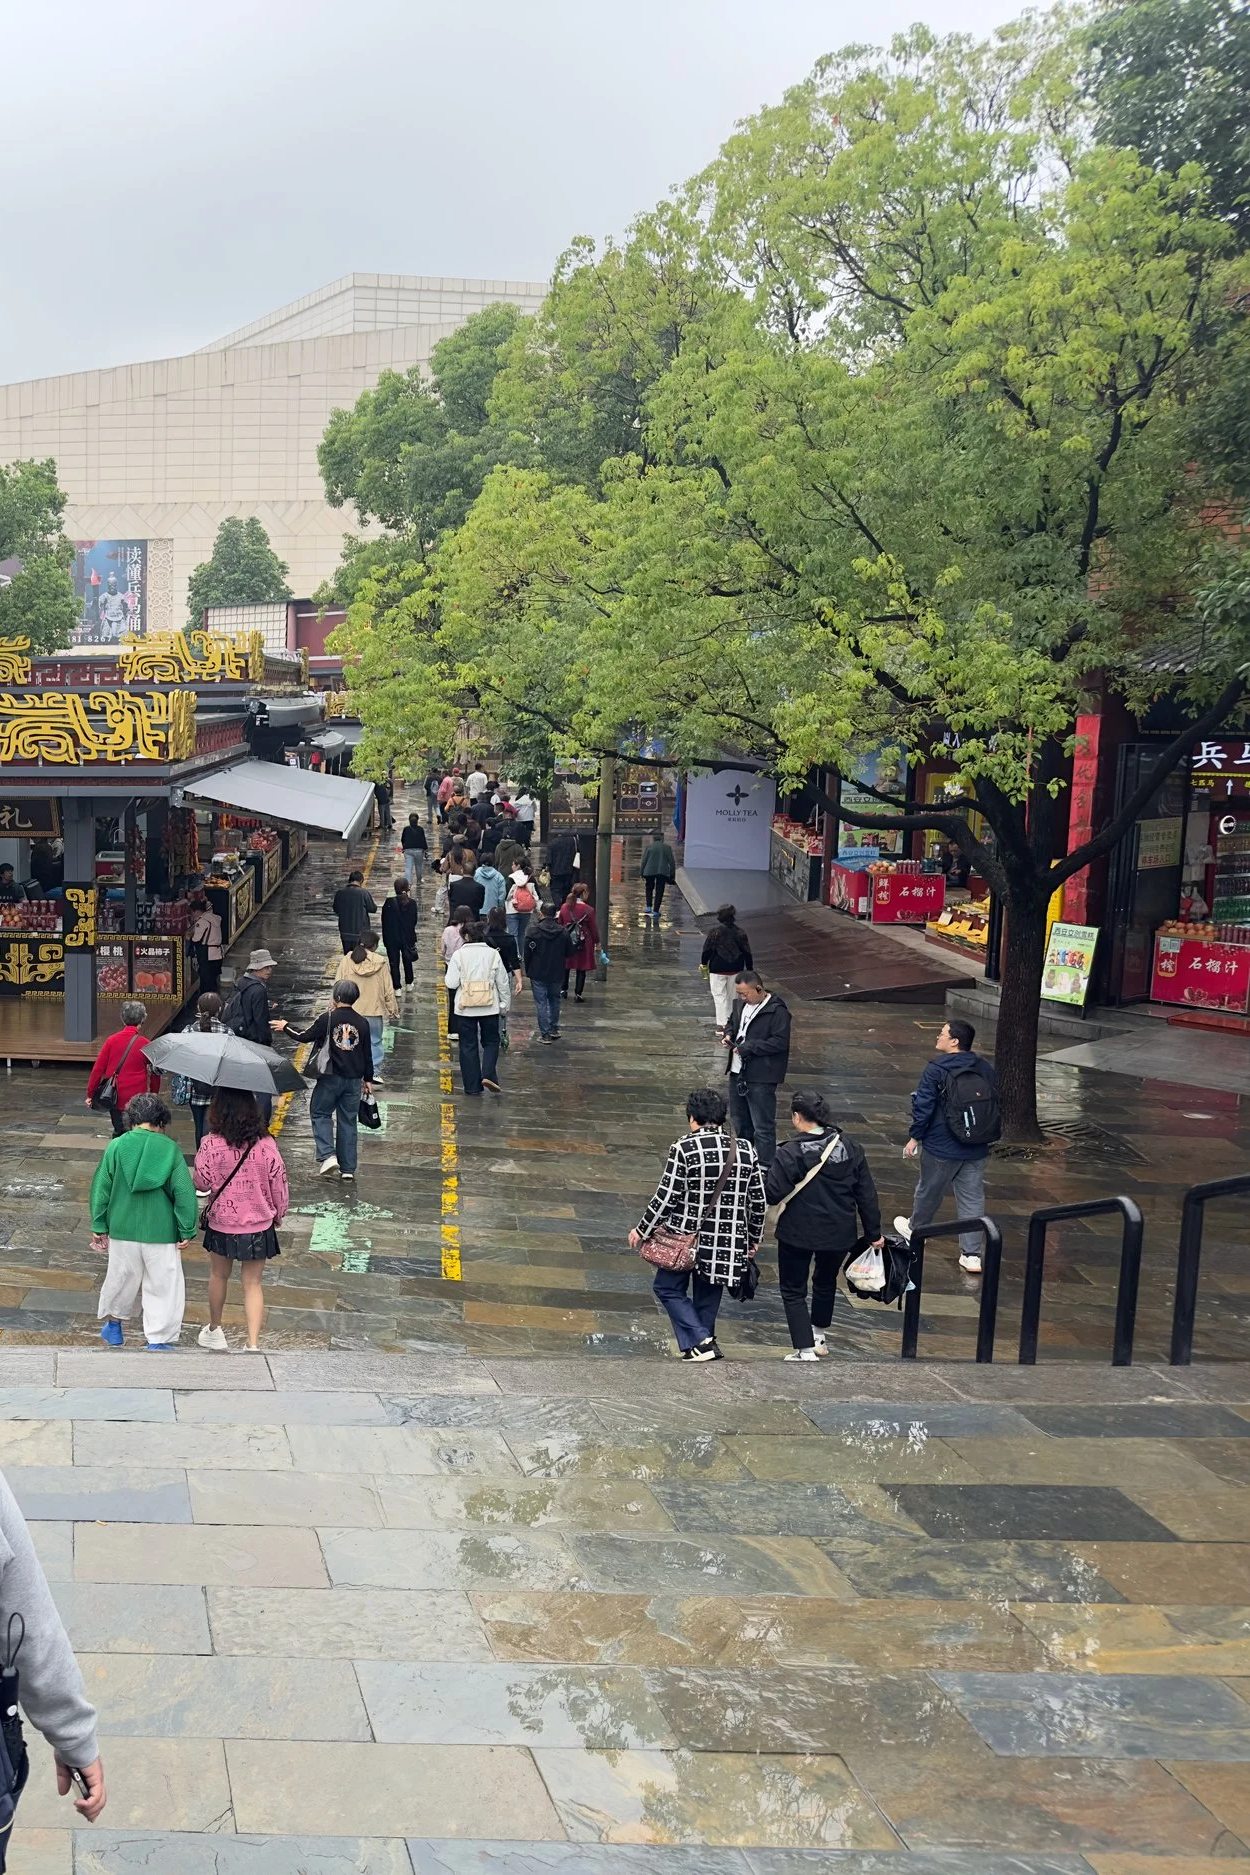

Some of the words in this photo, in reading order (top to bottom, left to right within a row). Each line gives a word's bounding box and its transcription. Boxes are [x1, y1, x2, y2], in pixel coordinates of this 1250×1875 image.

[742, 809, 758, 817] TEA
[877, 877, 890, 901] 鲜榨
[899, 886, 937, 898] 石榴汁
[99, 946, 124, 956] 樱桃
[1188, 957, 1239, 976] 石榴汁
